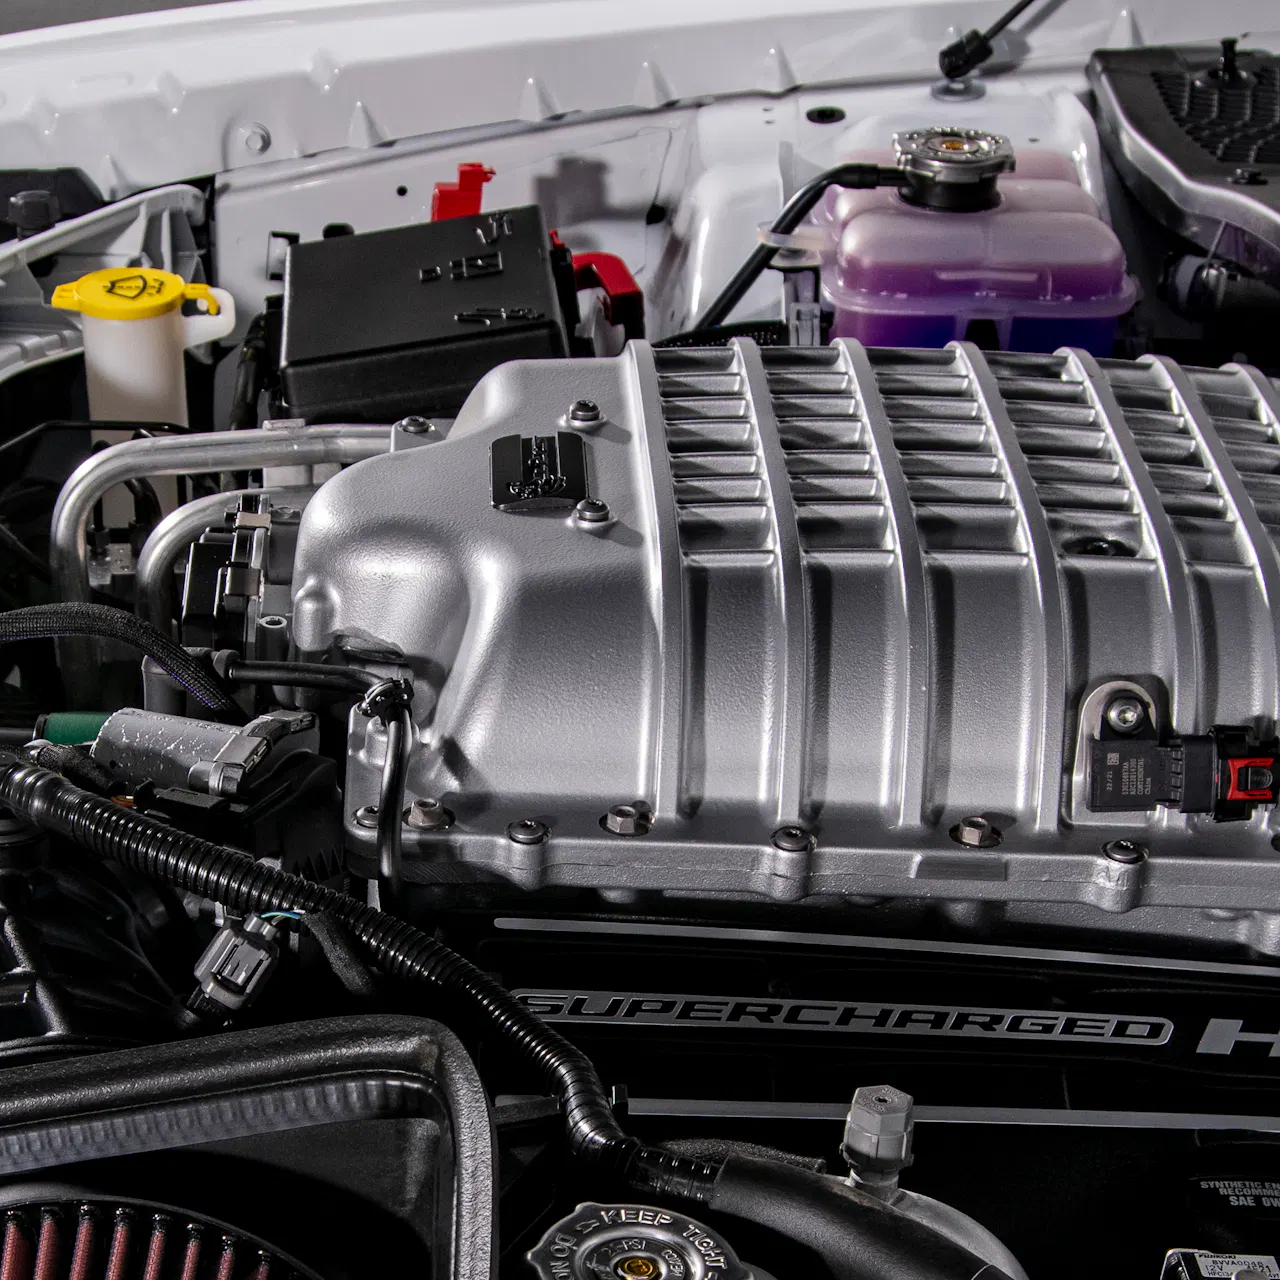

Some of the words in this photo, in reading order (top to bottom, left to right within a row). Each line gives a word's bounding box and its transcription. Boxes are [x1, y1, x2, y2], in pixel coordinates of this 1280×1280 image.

[516, 993, 1167, 1040] SUPERCHARGED
[1199, 1180, 1263, 1190] SYNTHETIC
[1228, 1195, 1257, 1207] SAE
[550, 1232, 579, 1258] DO
[600, 1209, 674, 1226] KEEP
[681, 1224, 728, 1271] TIGHT
